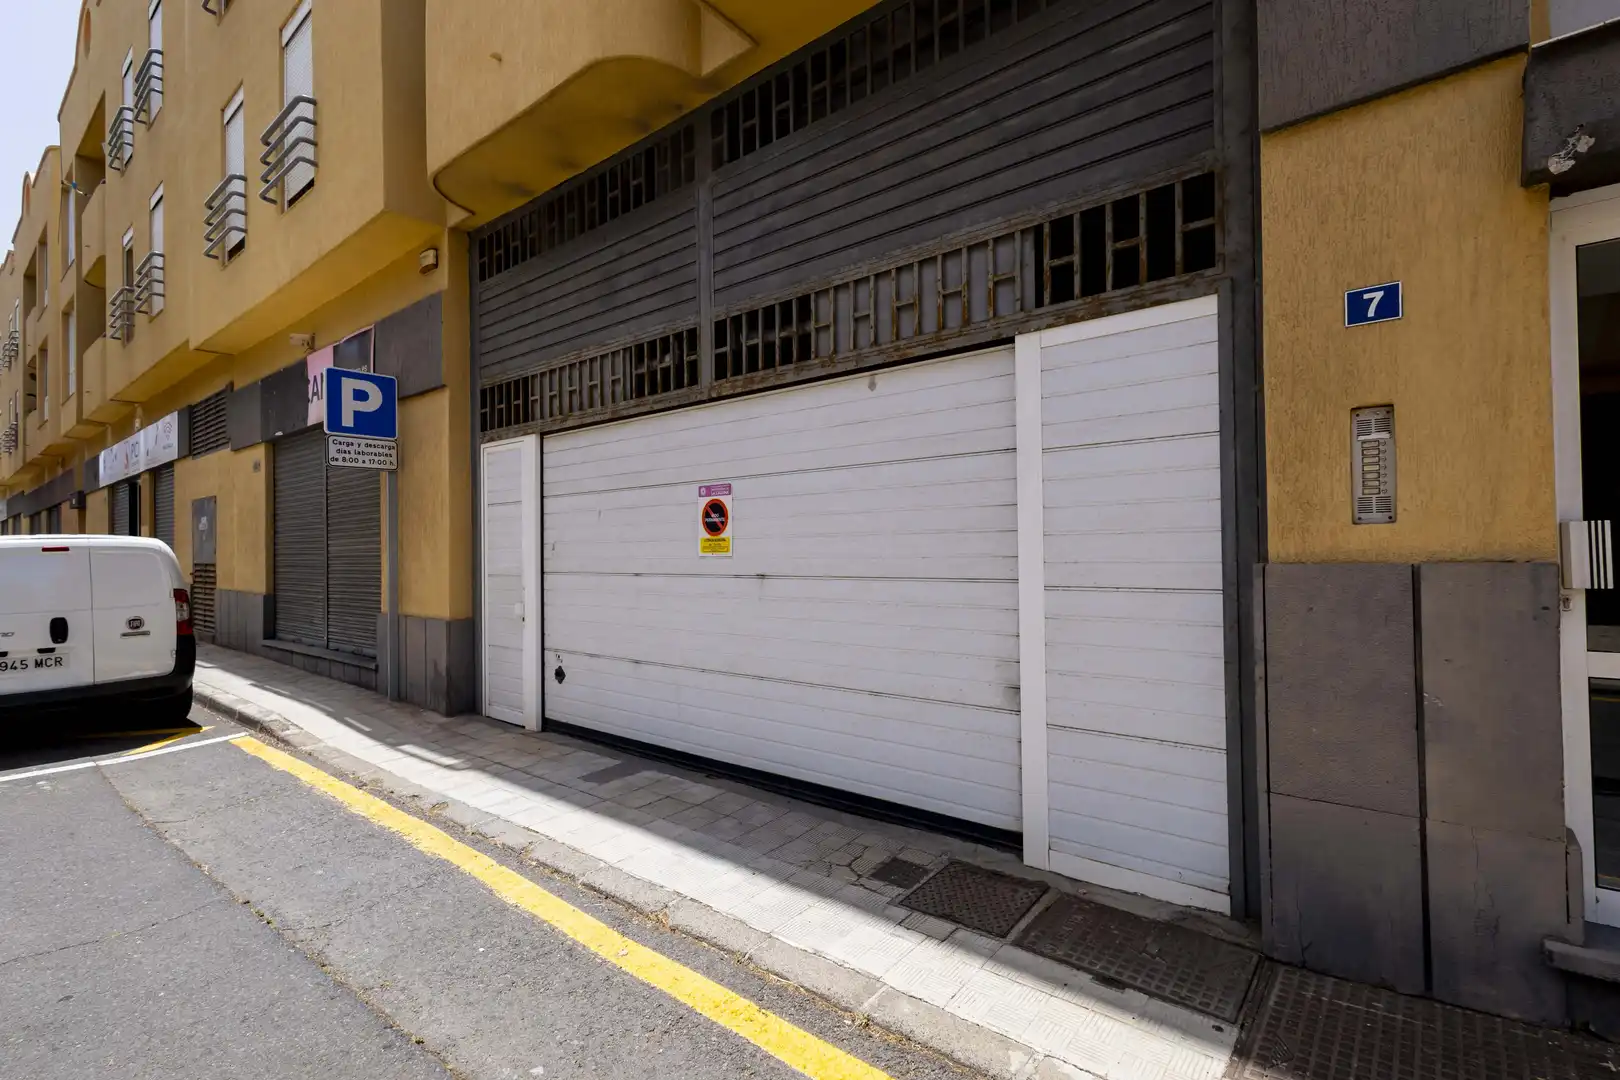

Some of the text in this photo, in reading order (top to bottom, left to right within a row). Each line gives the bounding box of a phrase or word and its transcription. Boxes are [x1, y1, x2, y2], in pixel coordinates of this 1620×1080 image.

[1363, 290, 1384, 317] 7
[341, 376, 383, 428] P
[332, 439, 354, 447] Carga
[365, 442, 395, 451] descarga
[354, 449, 393, 458] laborables
[34, 657, 63, 669] MCR
